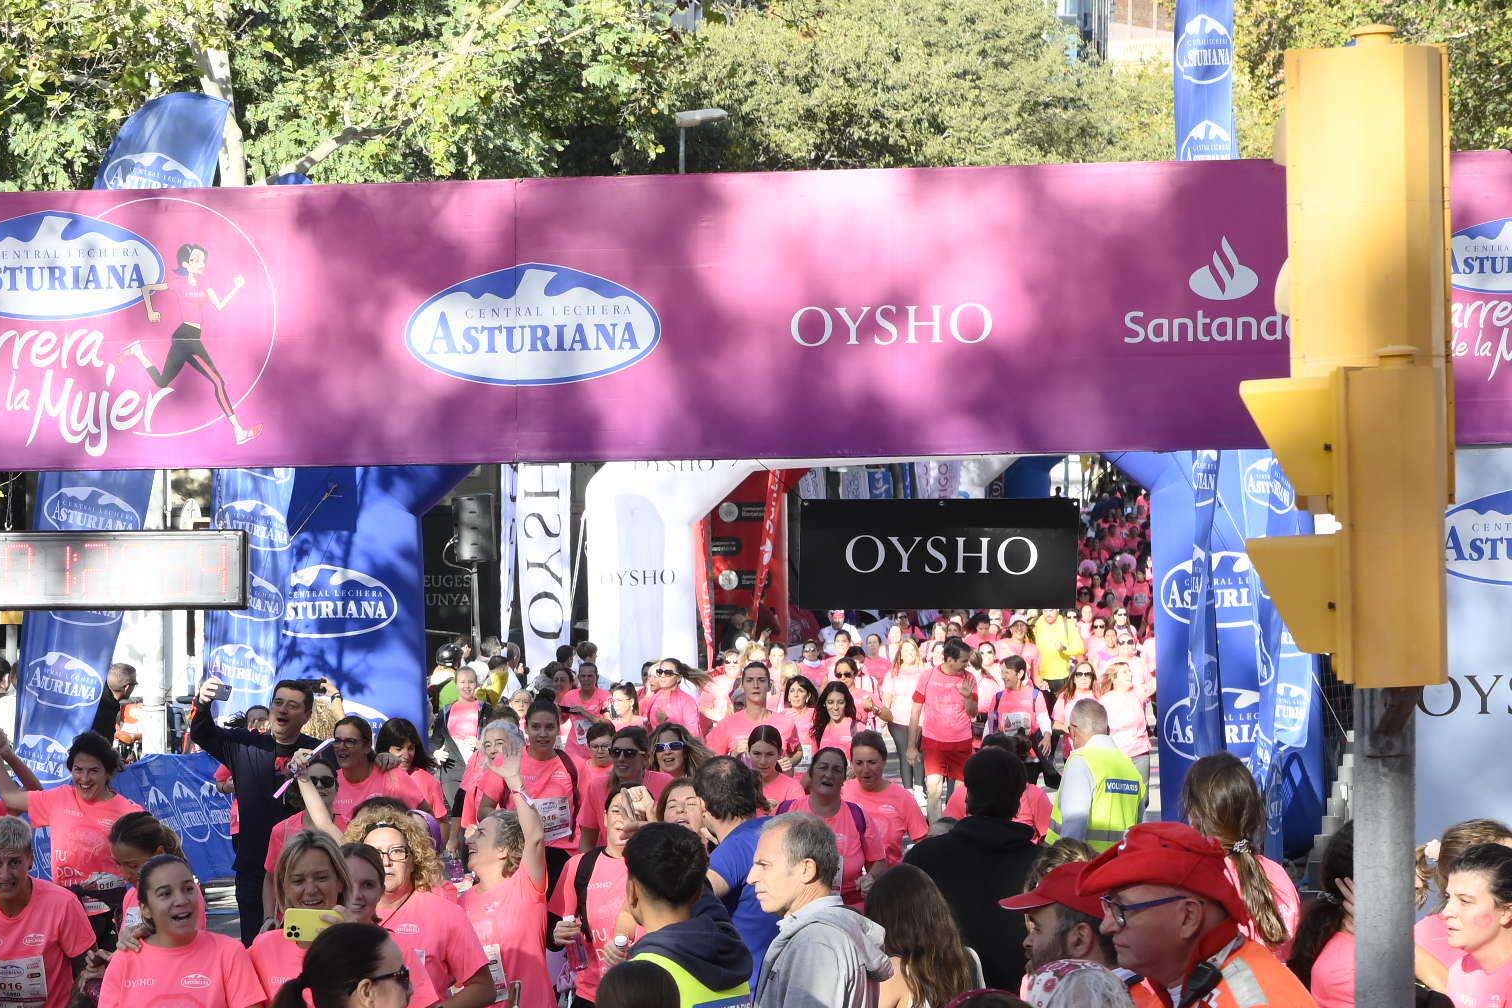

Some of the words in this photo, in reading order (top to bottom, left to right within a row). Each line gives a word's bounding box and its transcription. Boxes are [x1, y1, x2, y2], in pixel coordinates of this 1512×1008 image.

[65, 246, 140, 259] LECHERA
[1465, 244, 1512, 253] CENTRA
[465, 306, 543, 319] CENTRAL
[551, 304, 632, 317] LECHERA
[425, 311, 640, 355] ASTURIANA
[790, 303, 993, 347] OYSHO
[1474, 330, 1492, 356] la
[6, 371, 30, 411] la
[25, 363, 175, 457] Mujer
[51, 500, 134, 531] ASTURIANA
[1472, 522, 1512, 531] CENT
[523, 463, 565, 640] OYSH
[845, 535, 1038, 576] OYSHO
[288, 590, 329, 599] CENTRAL
[334, 588, 383, 598] LECHERA
[284, 600, 387, 620] STURIANA
[1417, 675, 1512, 716] OY
[0, 982, 22, 991] 016
